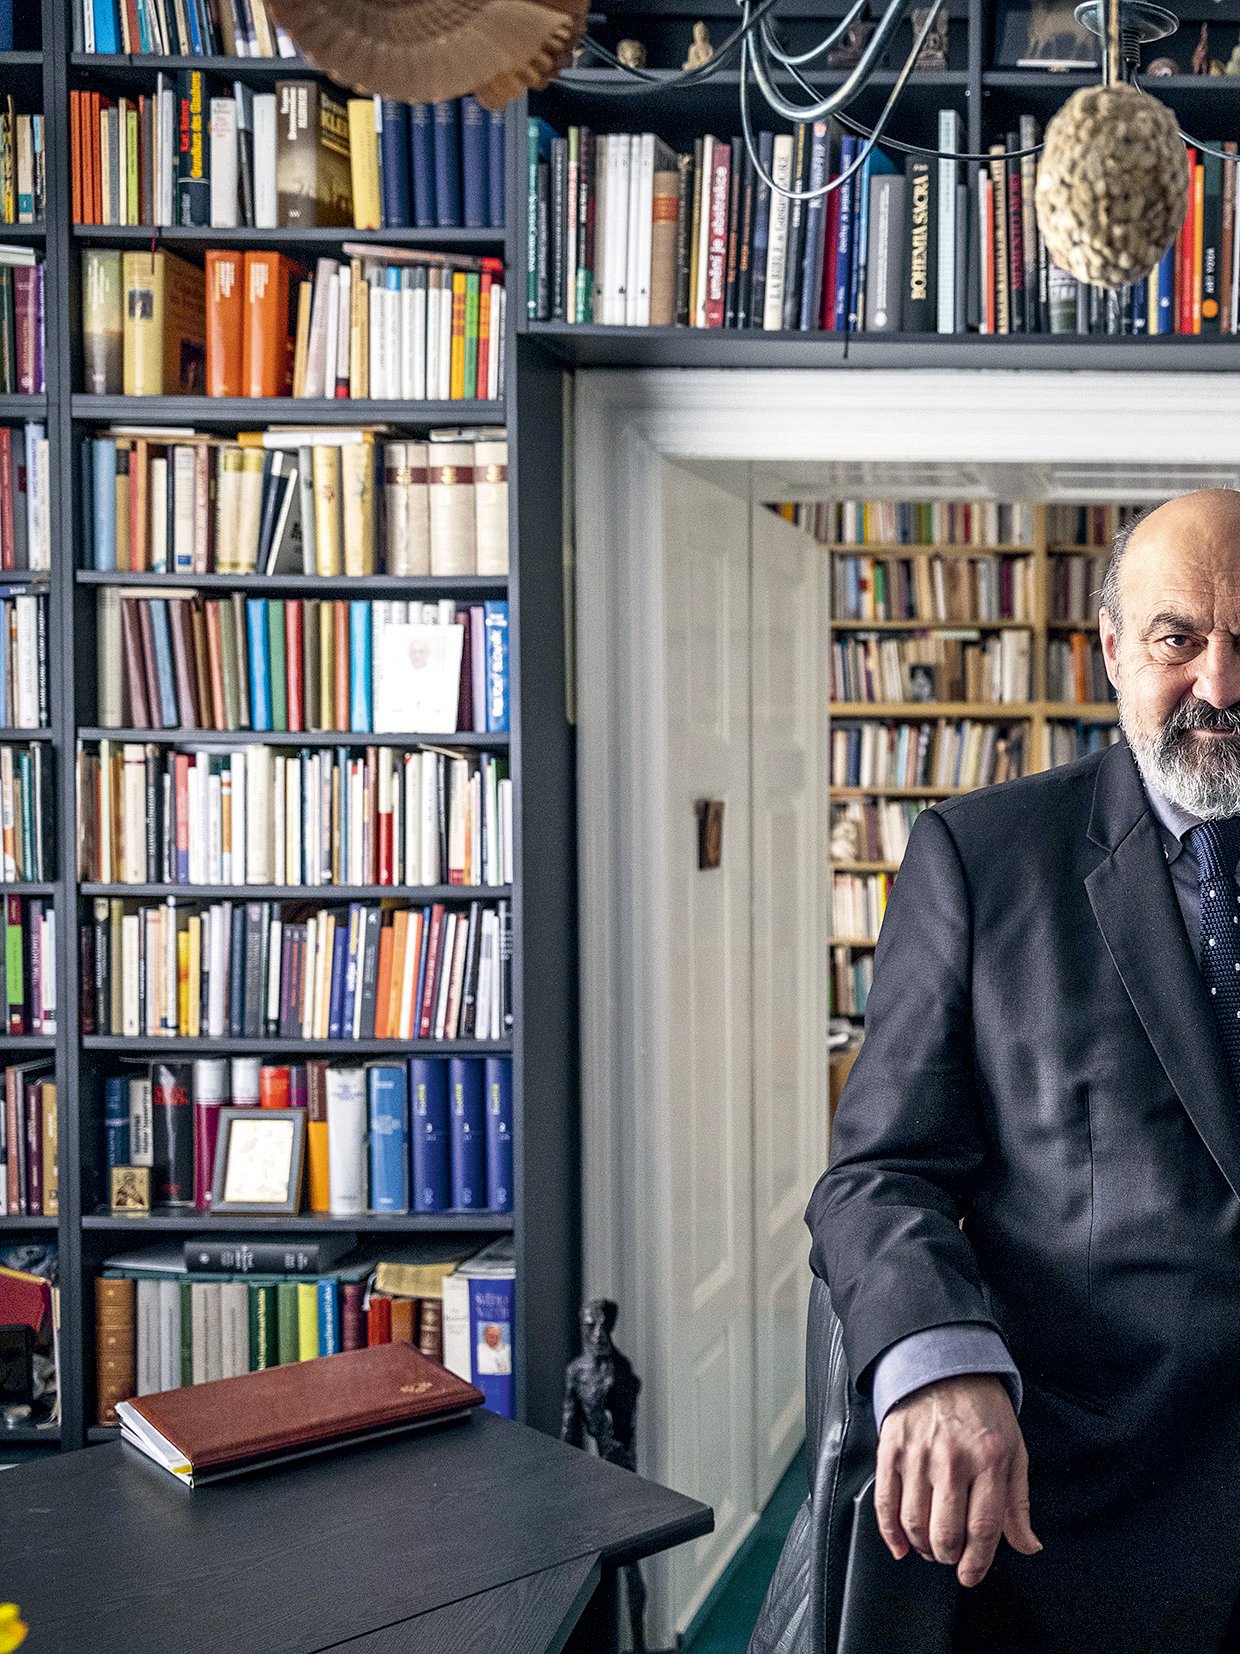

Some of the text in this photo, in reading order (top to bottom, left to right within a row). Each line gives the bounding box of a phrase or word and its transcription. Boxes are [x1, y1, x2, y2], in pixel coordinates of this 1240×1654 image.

[190, 71, 203, 178] Grundkurs des Glaubens
[709, 166, 728, 300] umění je abstrakce
[911, 174, 929, 225] SACRA
[910, 225, 929, 301] BOHEMIA
